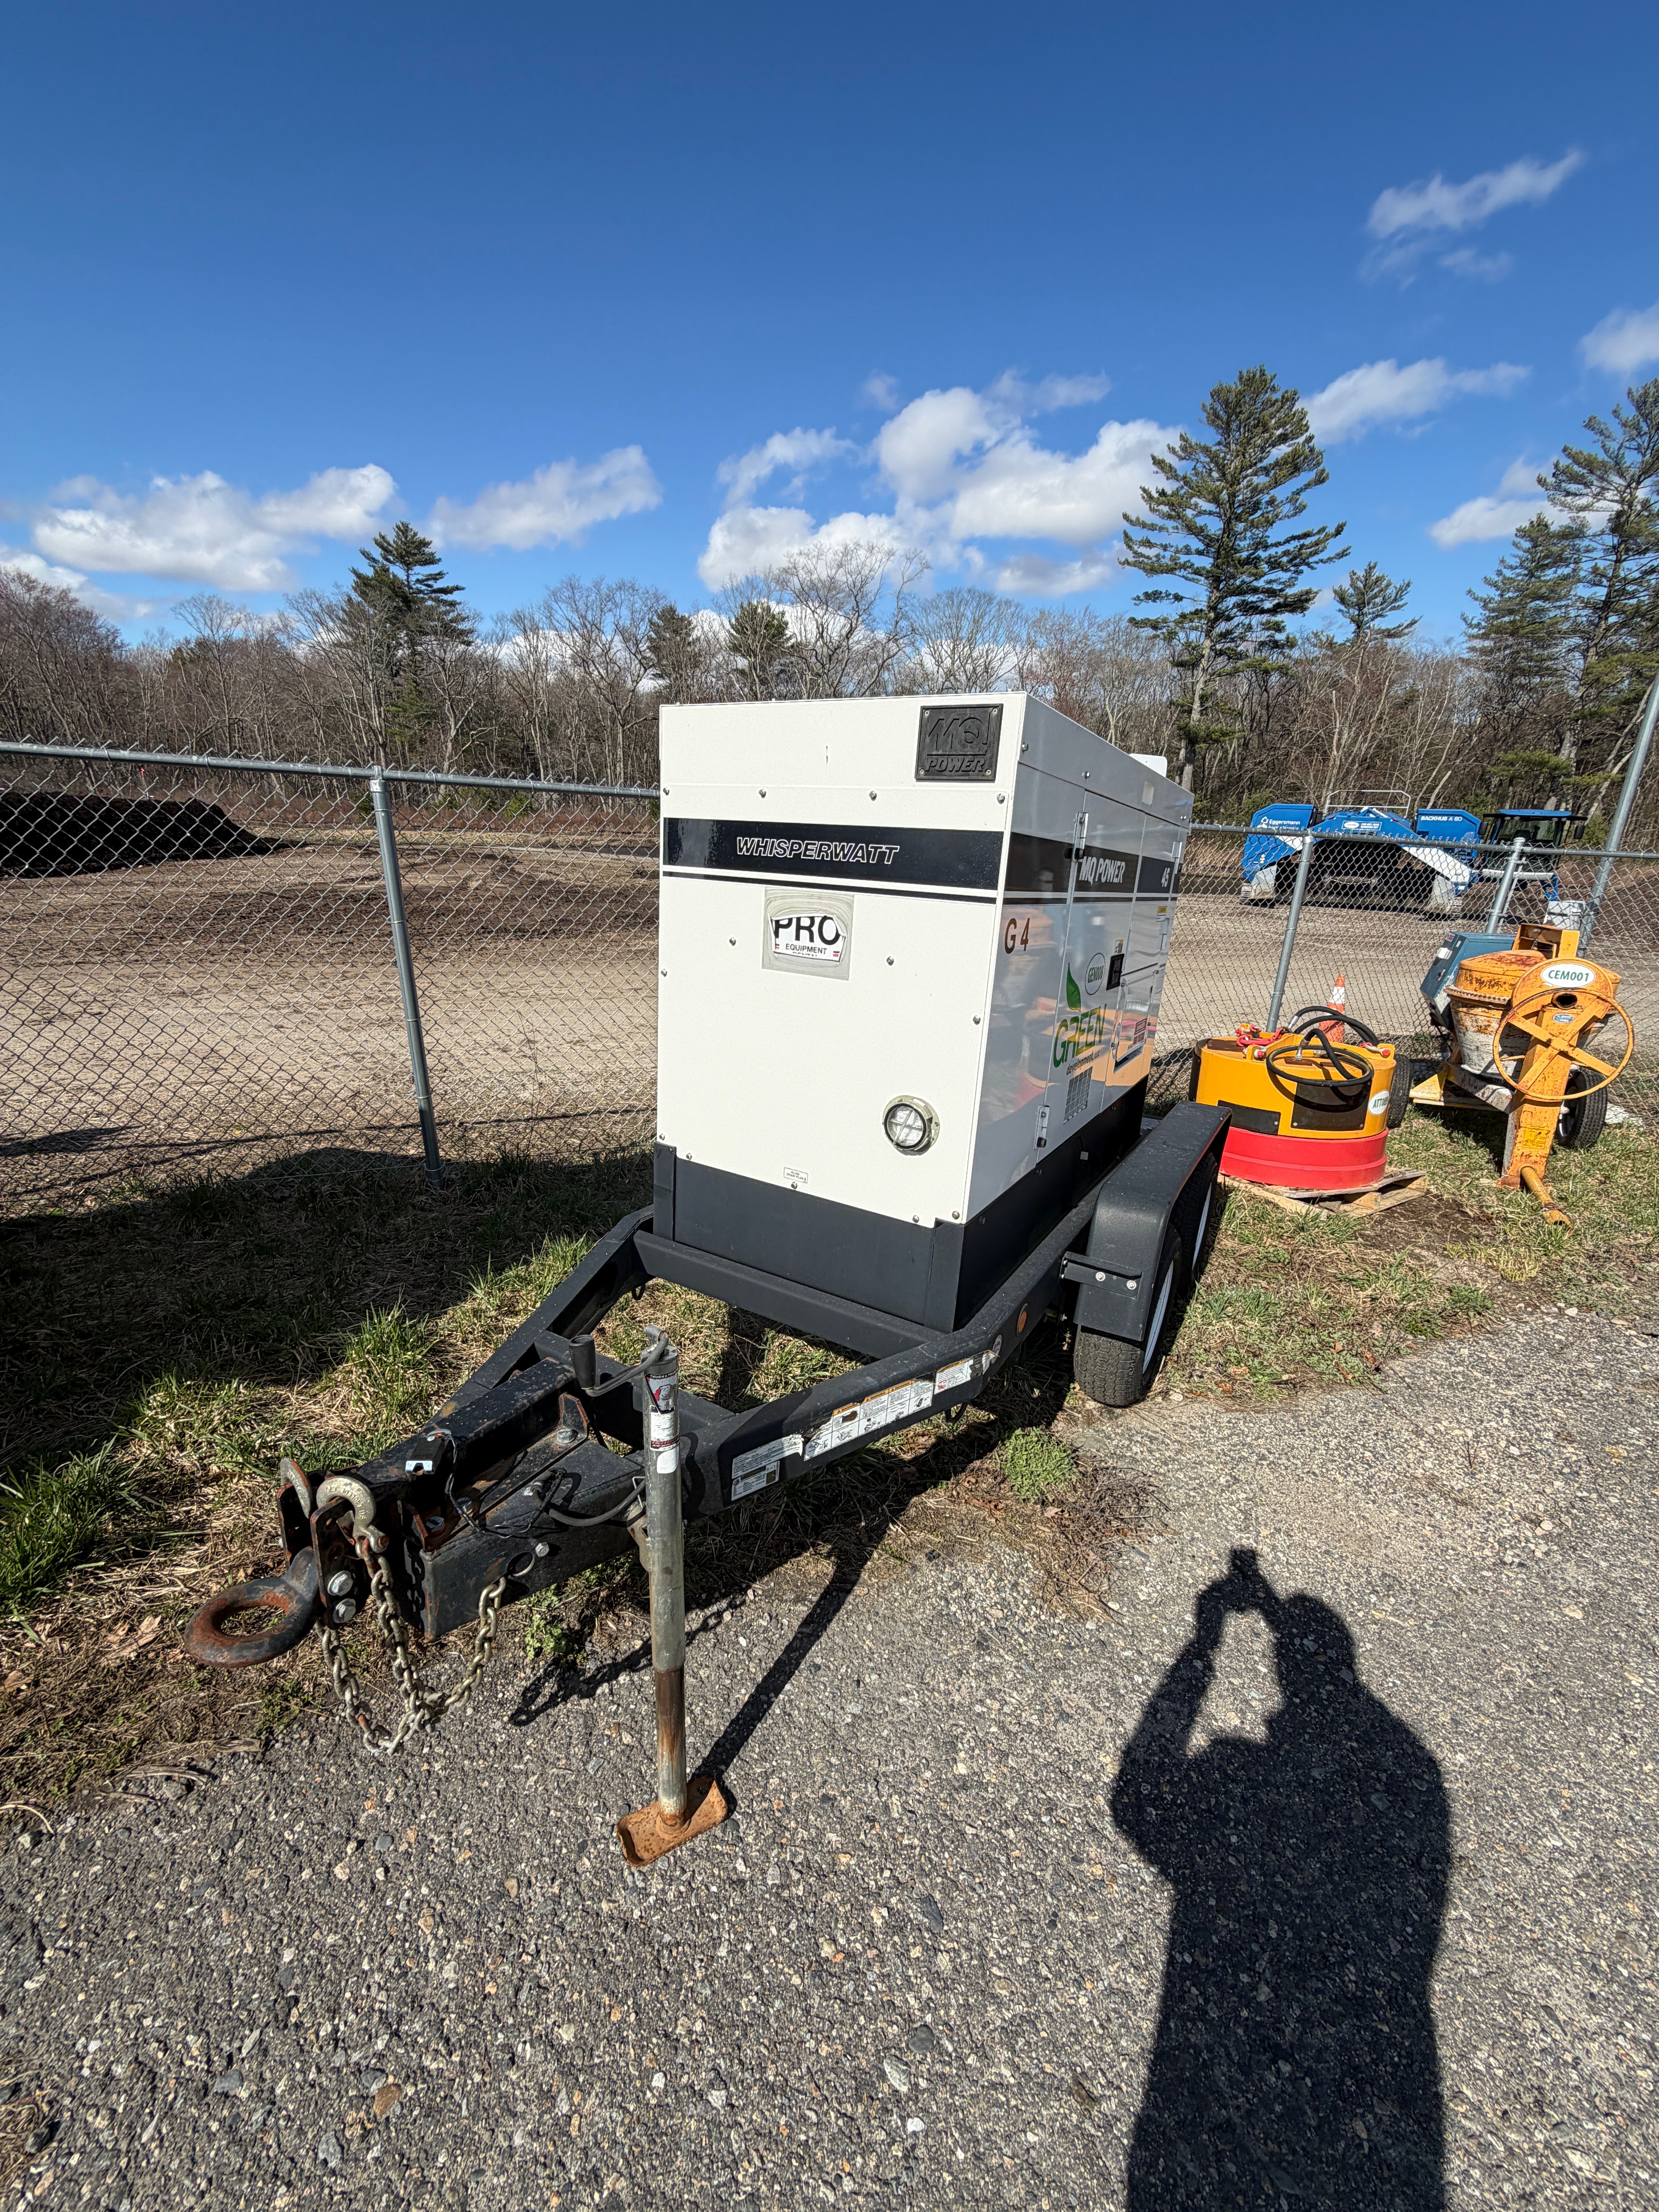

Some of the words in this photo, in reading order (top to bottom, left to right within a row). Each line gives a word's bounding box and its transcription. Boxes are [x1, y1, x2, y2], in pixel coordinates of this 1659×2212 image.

[926, 757, 986, 772] POWER
[737, 837, 900, 864] WHISPERWATT
[1079, 856, 1097, 886] MQ
[1095, 858, 1125, 883] POWER
[1161, 867, 1170, 888] 45
[774, 915, 841, 945] PRO
[785, 943, 827, 955] EQUIPMENT
[1548, 970, 1589, 982] CEM001
[1053, 1003, 1107, 1068] GREEN
